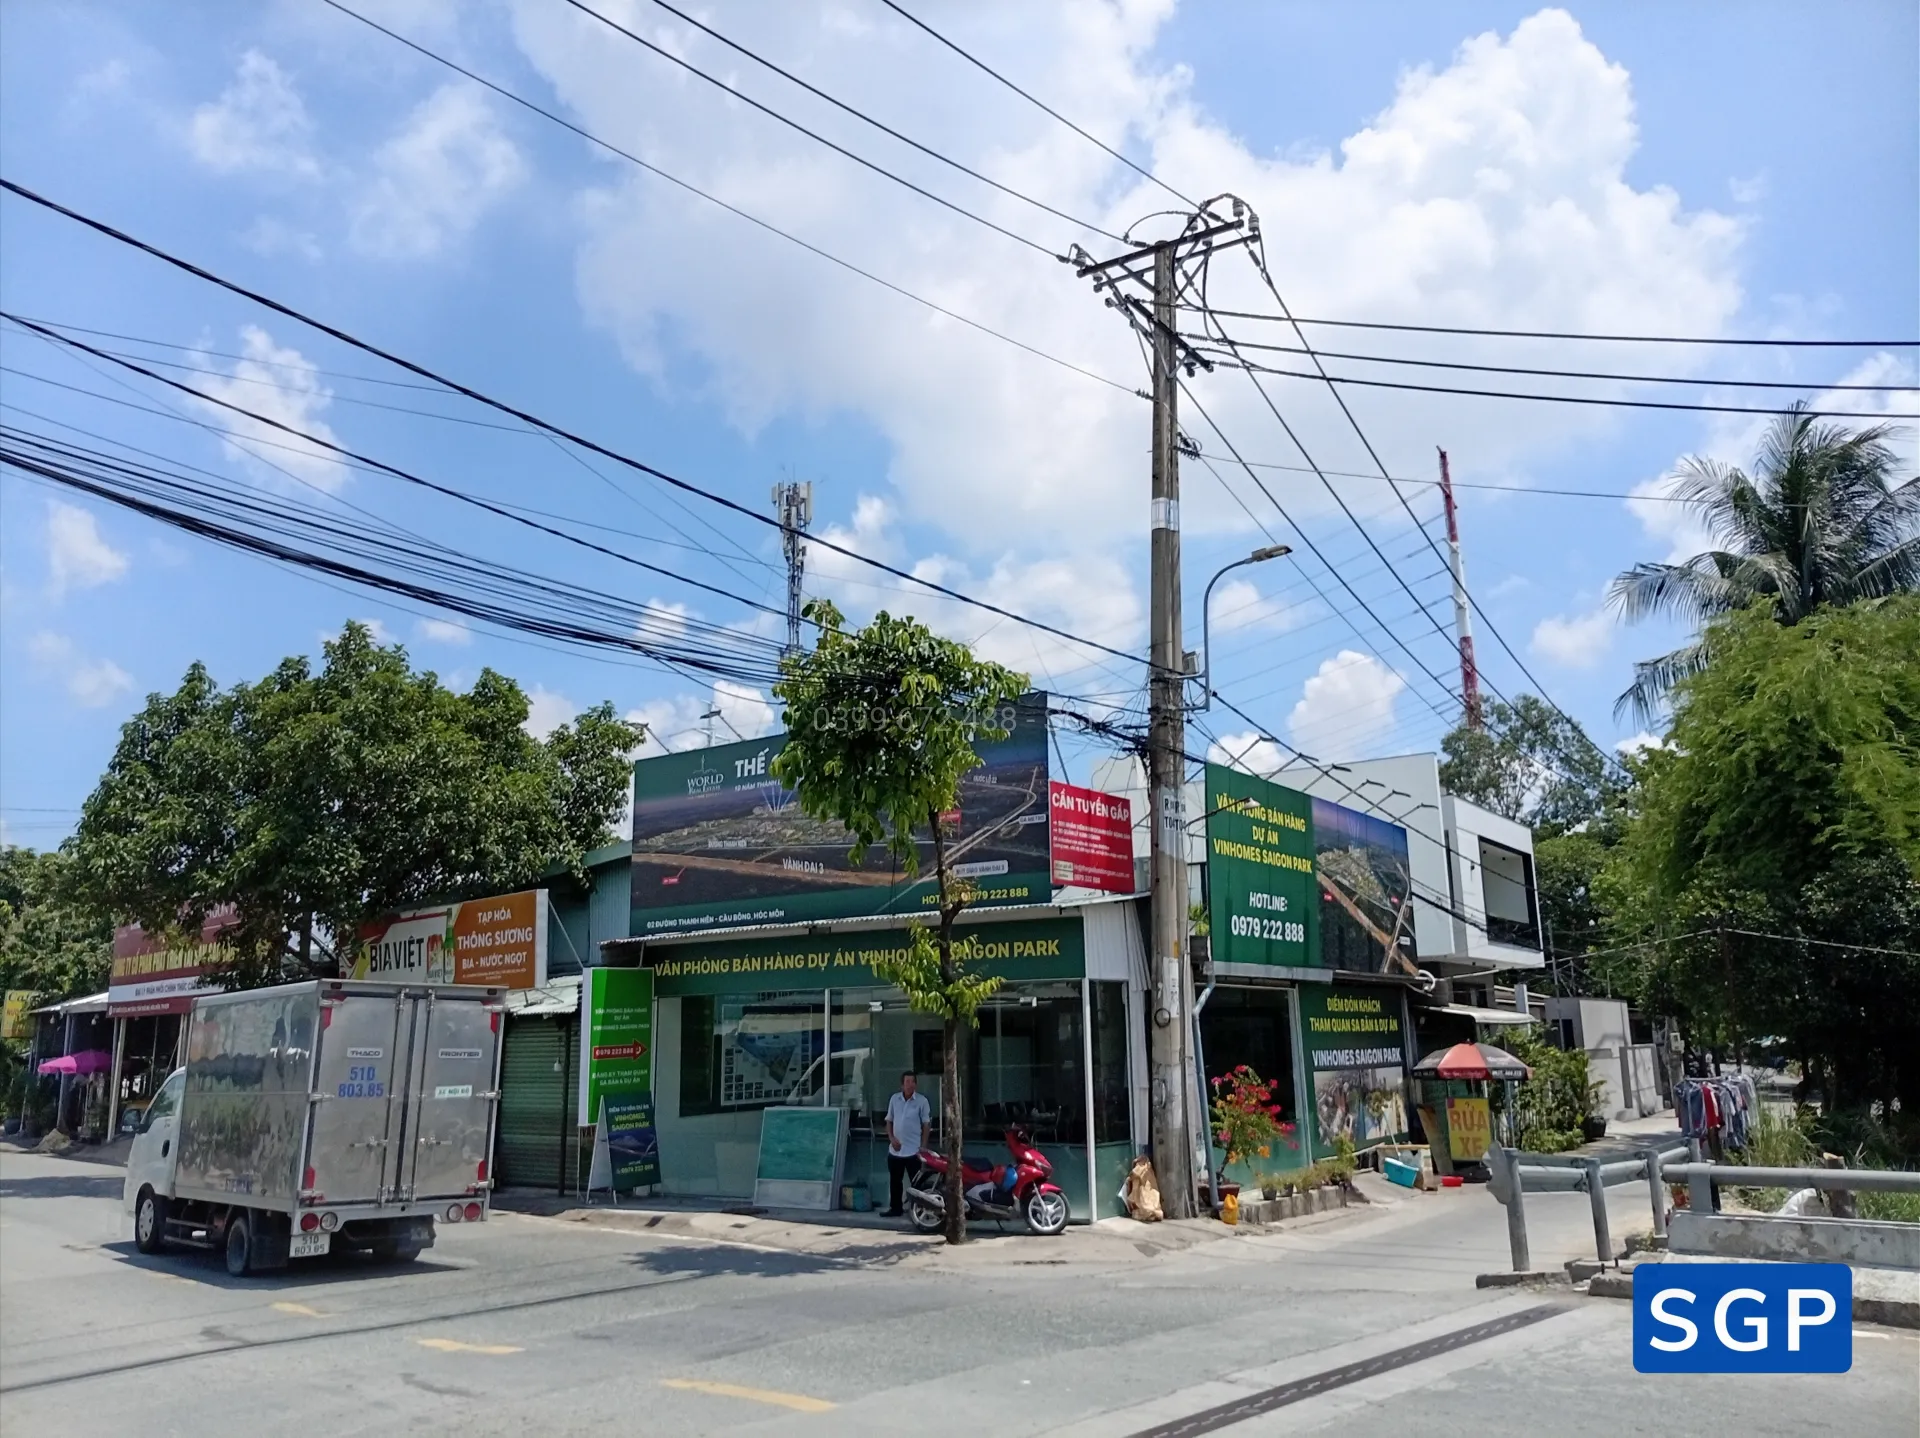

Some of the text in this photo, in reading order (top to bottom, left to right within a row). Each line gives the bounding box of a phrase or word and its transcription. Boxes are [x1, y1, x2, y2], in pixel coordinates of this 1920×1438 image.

[734, 748, 770, 778] THẾ
[687, 773, 724, 787] WORLD
[1216, 793, 1236, 813] VĂN
[1267, 806, 1285, 826] BÁN
[1284, 811, 1306, 833] HÀNG
[1252, 825, 1279, 845] DỰ ÁN
[783, 856, 804, 873] VÀNH
[819, 863, 825, 874] 3
[1213, 838, 1313, 874] VINHOMES SAIGON PARK
[990, 889, 1008, 899] 222
[1009, 887, 1029, 897] 888
[1249, 891, 1288, 912] HOTLINE:
[478, 911, 493, 926] TẠP
[1231, 914, 1305, 943] 0979 222 888
[457, 926, 533, 950] THÔNG SƯƠNG
[462, 958, 475, 970] BIA
[480, 952, 503, 967] NƯỚC
[504, 951, 528, 967] NGỌT
[655, 960, 681, 976] VĂN
[683, 956, 730, 974] PHÒNG
[733, 953, 761, 972] BÁN
[764, 951, 805, 969] HÀNG
[808, 952, 830, 971] DỰ
[834, 948, 855, 965] ÁN
[1013, 938, 1060, 957] PARK
[1309, 1017, 1331, 1032] THAM
[1331, 1018, 1351, 1033] QUAN
[1351, 1018, 1360, 1032] SA
[1311, 1046, 1401, 1067] VINHOMES SAIGON PARK
[349, 1066, 375, 1081] 51D
[338, 1083, 384, 1098] 803.85
[611, 1121, 650, 1131] SAIGON PARK
[614, 1112, 646, 1121] VINHOMES
[1448, 1101, 1488, 1132] RỬA
[1458, 1136, 1484, 1157] XE
